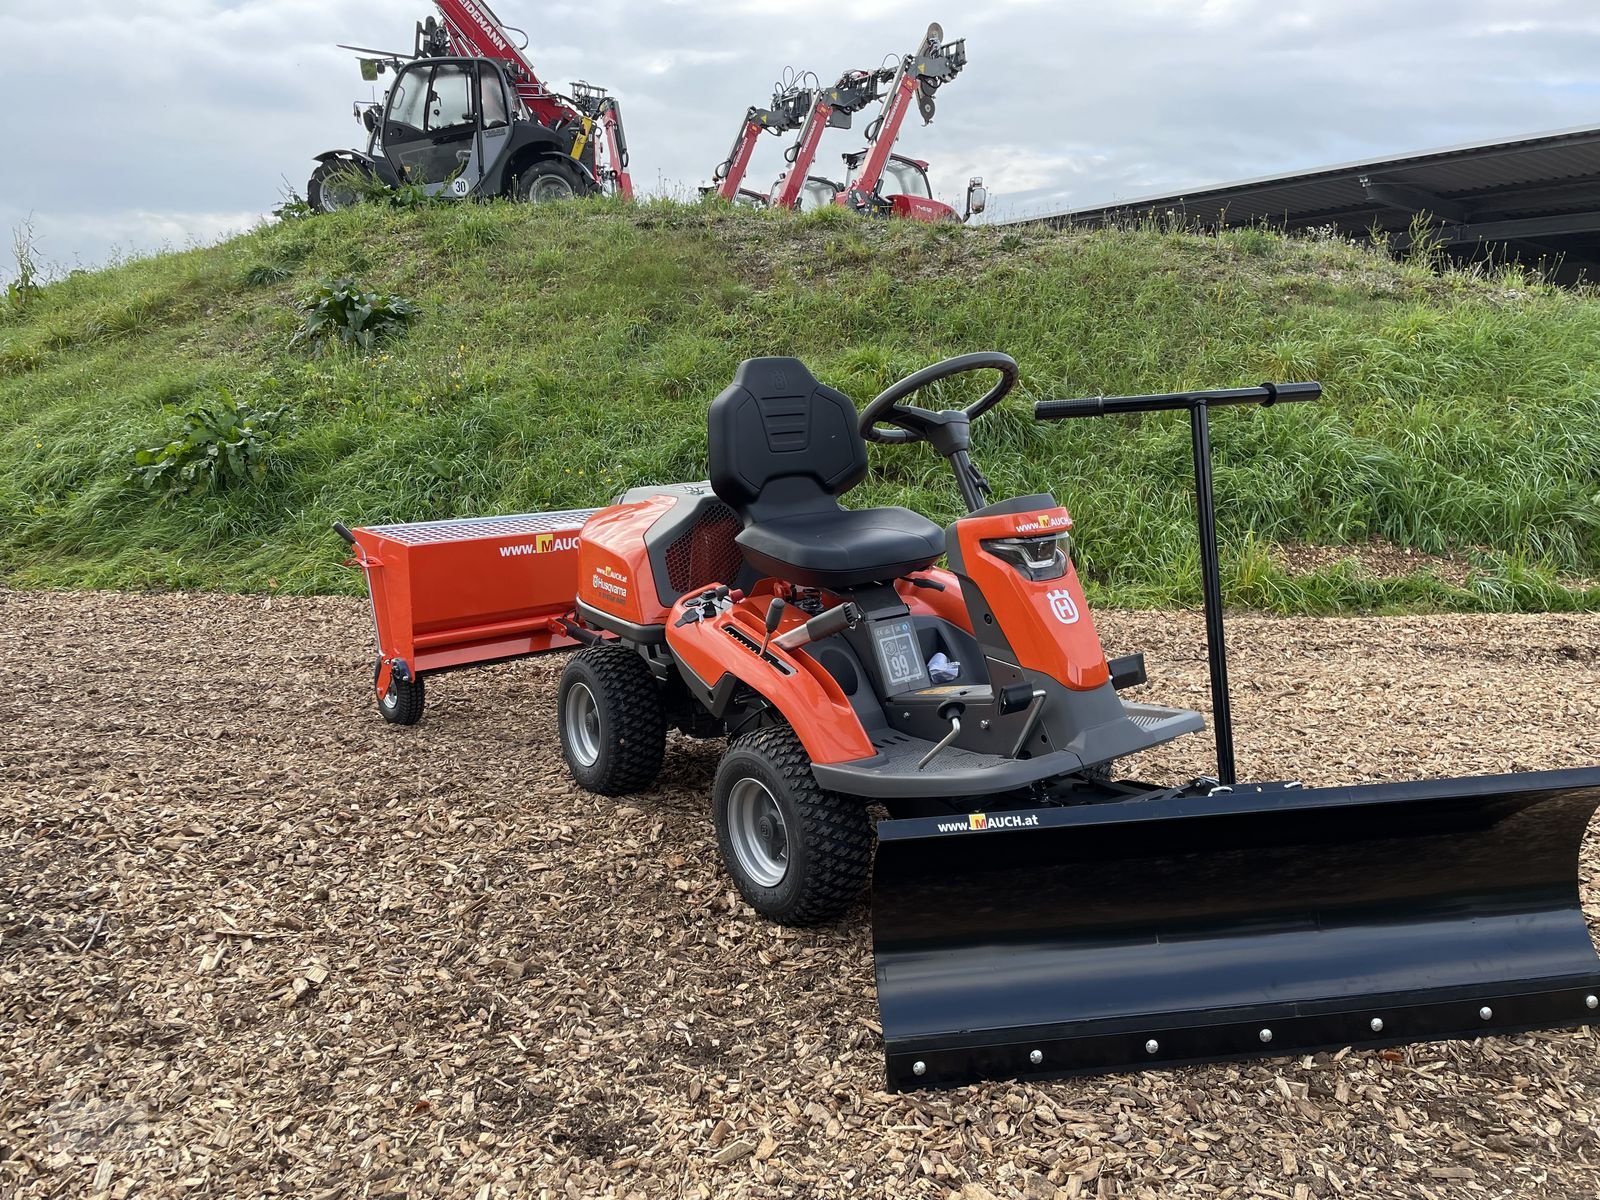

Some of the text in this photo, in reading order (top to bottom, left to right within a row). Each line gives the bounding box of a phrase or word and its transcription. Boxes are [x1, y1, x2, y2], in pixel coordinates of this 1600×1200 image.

[456, 181, 465, 193] 30
[598, 579, 627, 597] Husqvarna
[891, 655, 910, 677] 99
[938, 815, 1038, 833] www.MAUCH.at
